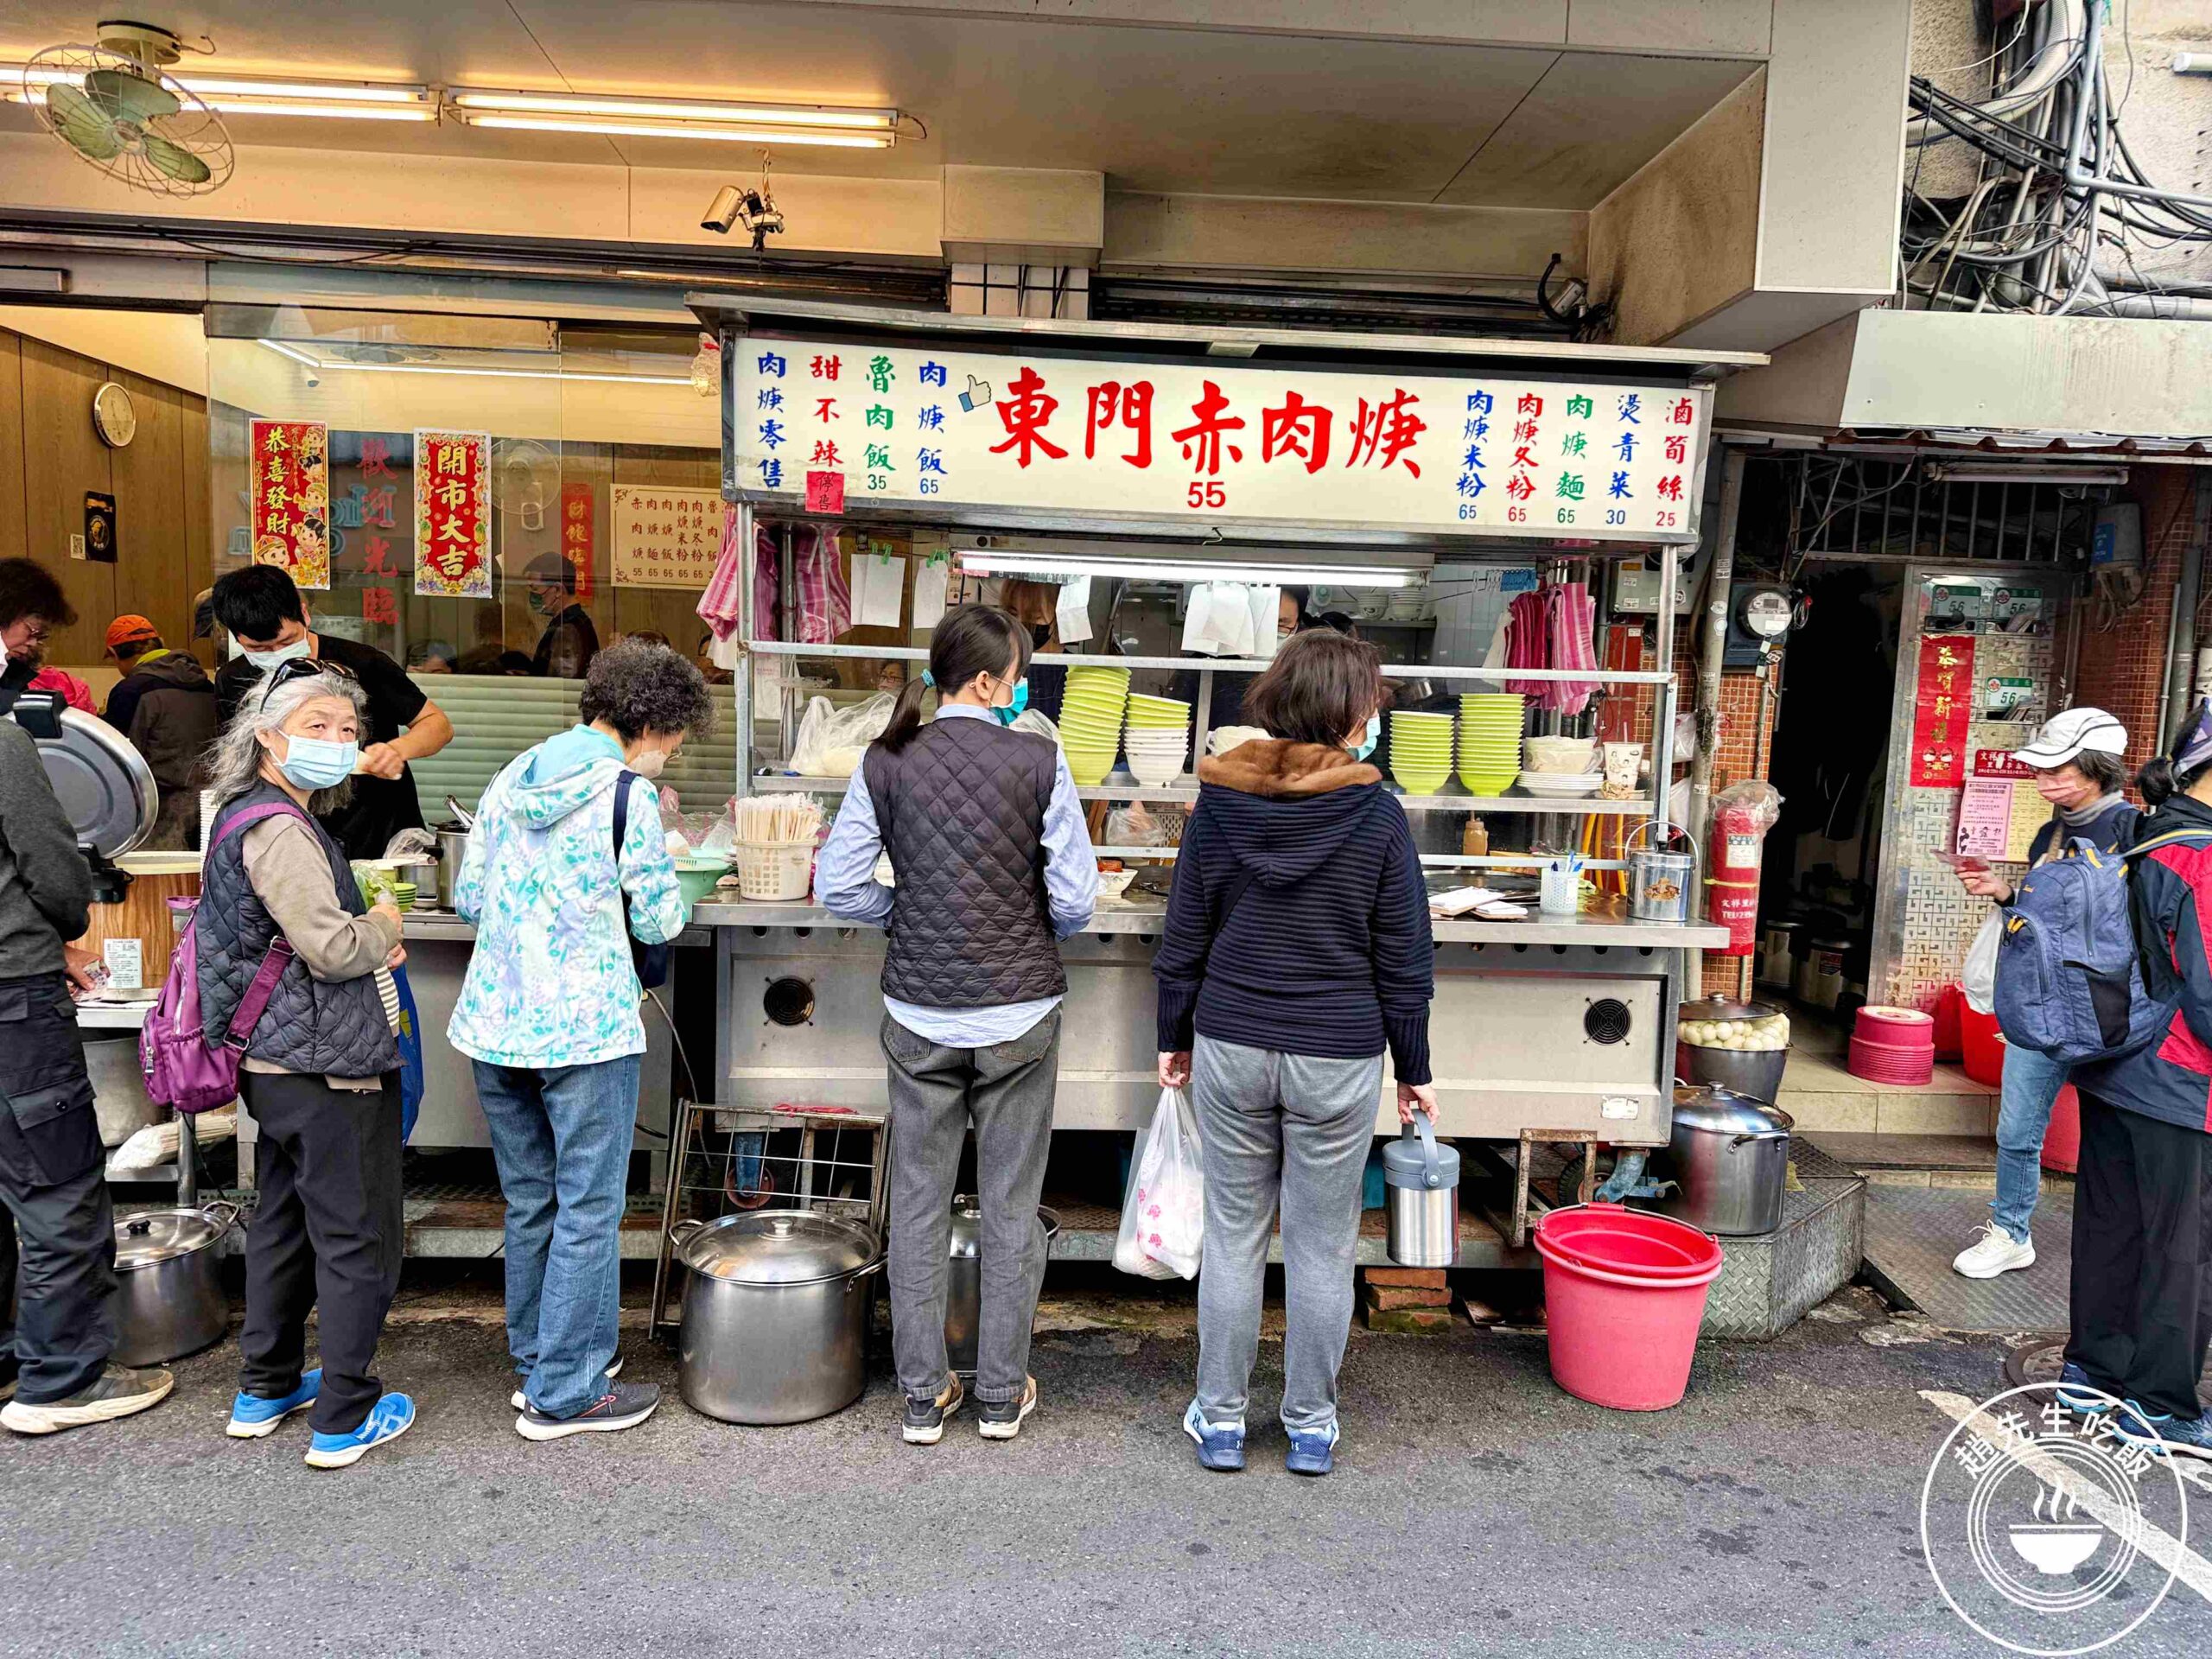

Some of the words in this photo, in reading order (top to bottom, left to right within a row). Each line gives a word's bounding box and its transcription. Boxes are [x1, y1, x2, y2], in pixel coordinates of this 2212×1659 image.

[757, 352, 786, 487] 肉焿零售
[809, 354, 844, 467] 甜不辣
[864, 355, 896, 472] 魯肉飯
[916, 360, 948, 474] 肉焿飯
[989, 366, 1427, 478] 東門赤肉焿
[1456, 389, 1494, 499] 肉焿米粉
[1506, 392, 1544, 501] 肉焿冬粉
[1556, 393, 1593, 501] 肉焿麵
[1605, 394, 1642, 499] 燙青菜
[1656, 397, 1694, 502] 滷筍絲
[263, 426, 292, 535] 恭喜發財
[868, 474, 887, 491] 35
[919, 478, 938, 494] 65
[1187, 481, 1226, 509] 55
[435, 446, 471, 576] 開市大吉
[1459, 504, 1477, 520] 65
[1508, 506, 1527, 522] 65
[1557, 507, 1575, 524] 65
[1605, 509, 1625, 524] 30
[1656, 511, 1675, 526] 25
[356, 438, 399, 625] 歡迎光臨
[632, 567, 643, 576] 55
[648, 567, 658, 576] 65
[663, 568, 673, 577] 65
[678, 569, 689, 578] 65
[693, 569, 703, 579] 65
[2009, 602, 2027, 615] 56
[2000, 692, 2017, 704] 56
